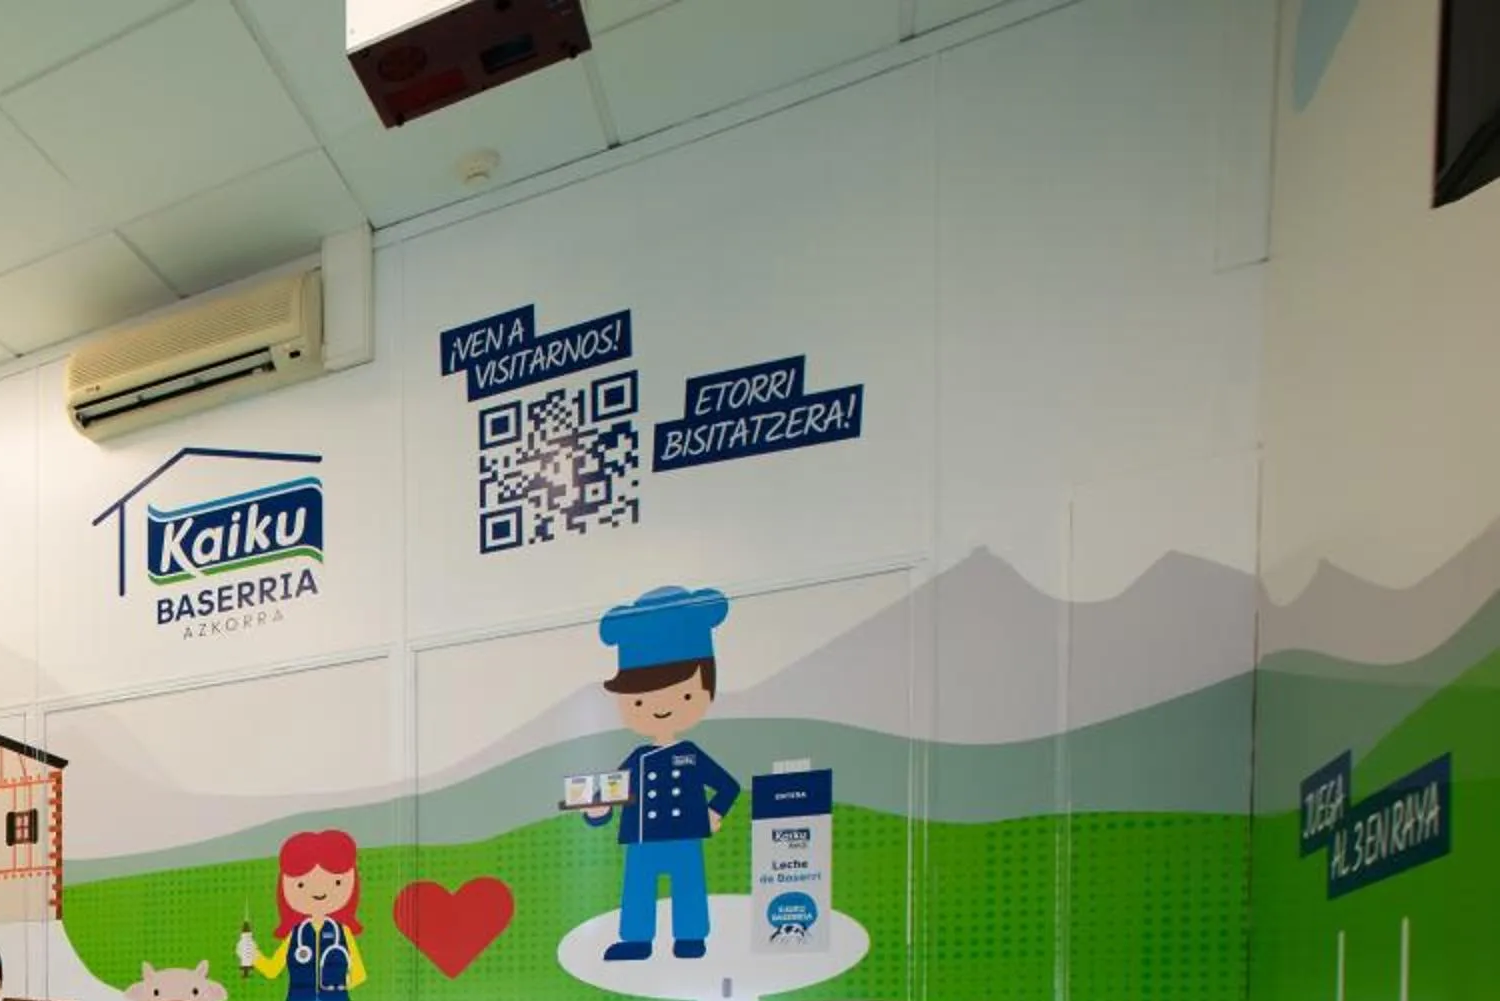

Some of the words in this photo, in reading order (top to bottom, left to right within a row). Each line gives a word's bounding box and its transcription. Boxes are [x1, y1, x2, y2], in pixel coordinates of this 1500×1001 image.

[450, 322, 505, 373] ¡VEN
[507, 317, 525, 347] A
[474, 319, 623, 391] VISITARNOS!
[693, 368, 797, 417] ETORRI
[660, 393, 857, 461] BISITATZERA!
[159, 503, 307, 577] Kaiku
[156, 568, 318, 625] BASERRIA
[183, 609, 285, 640] AZKORRA
[772, 859, 809, 871] Leche
